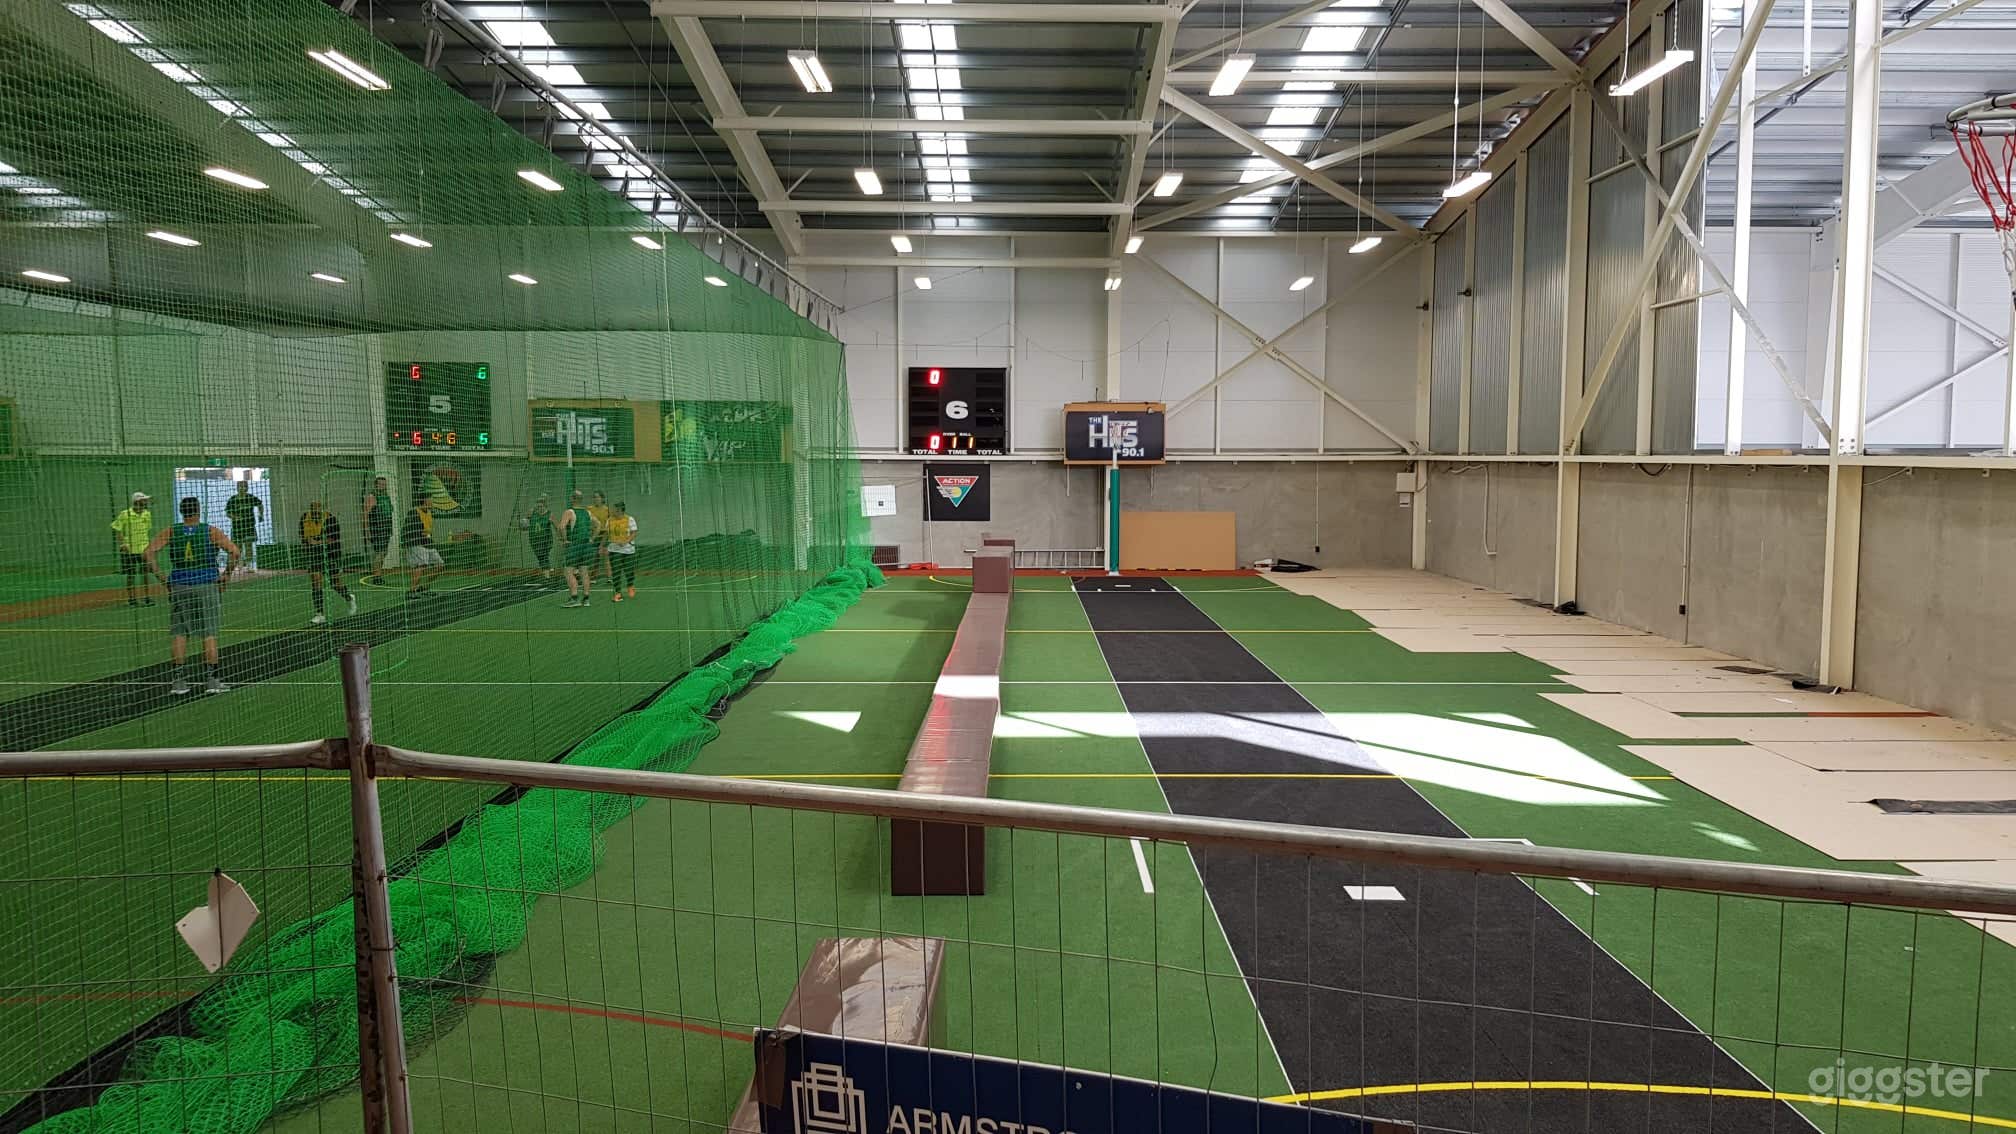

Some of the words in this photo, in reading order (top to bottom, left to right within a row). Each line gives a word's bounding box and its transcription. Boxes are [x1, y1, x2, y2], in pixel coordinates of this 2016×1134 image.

[478, 367, 486, 379] 6
[929, 370, 940, 385] 0
[429, 395, 452, 413] 5
[945, 400, 969, 420] 6
[1088, 416, 1103, 424] THE
[479, 433, 488, 445] 5
[929, 435, 940, 450] 0
[1121, 448, 1144, 457] 90.1
[886, 1105, 1078, 1134] ARMST
